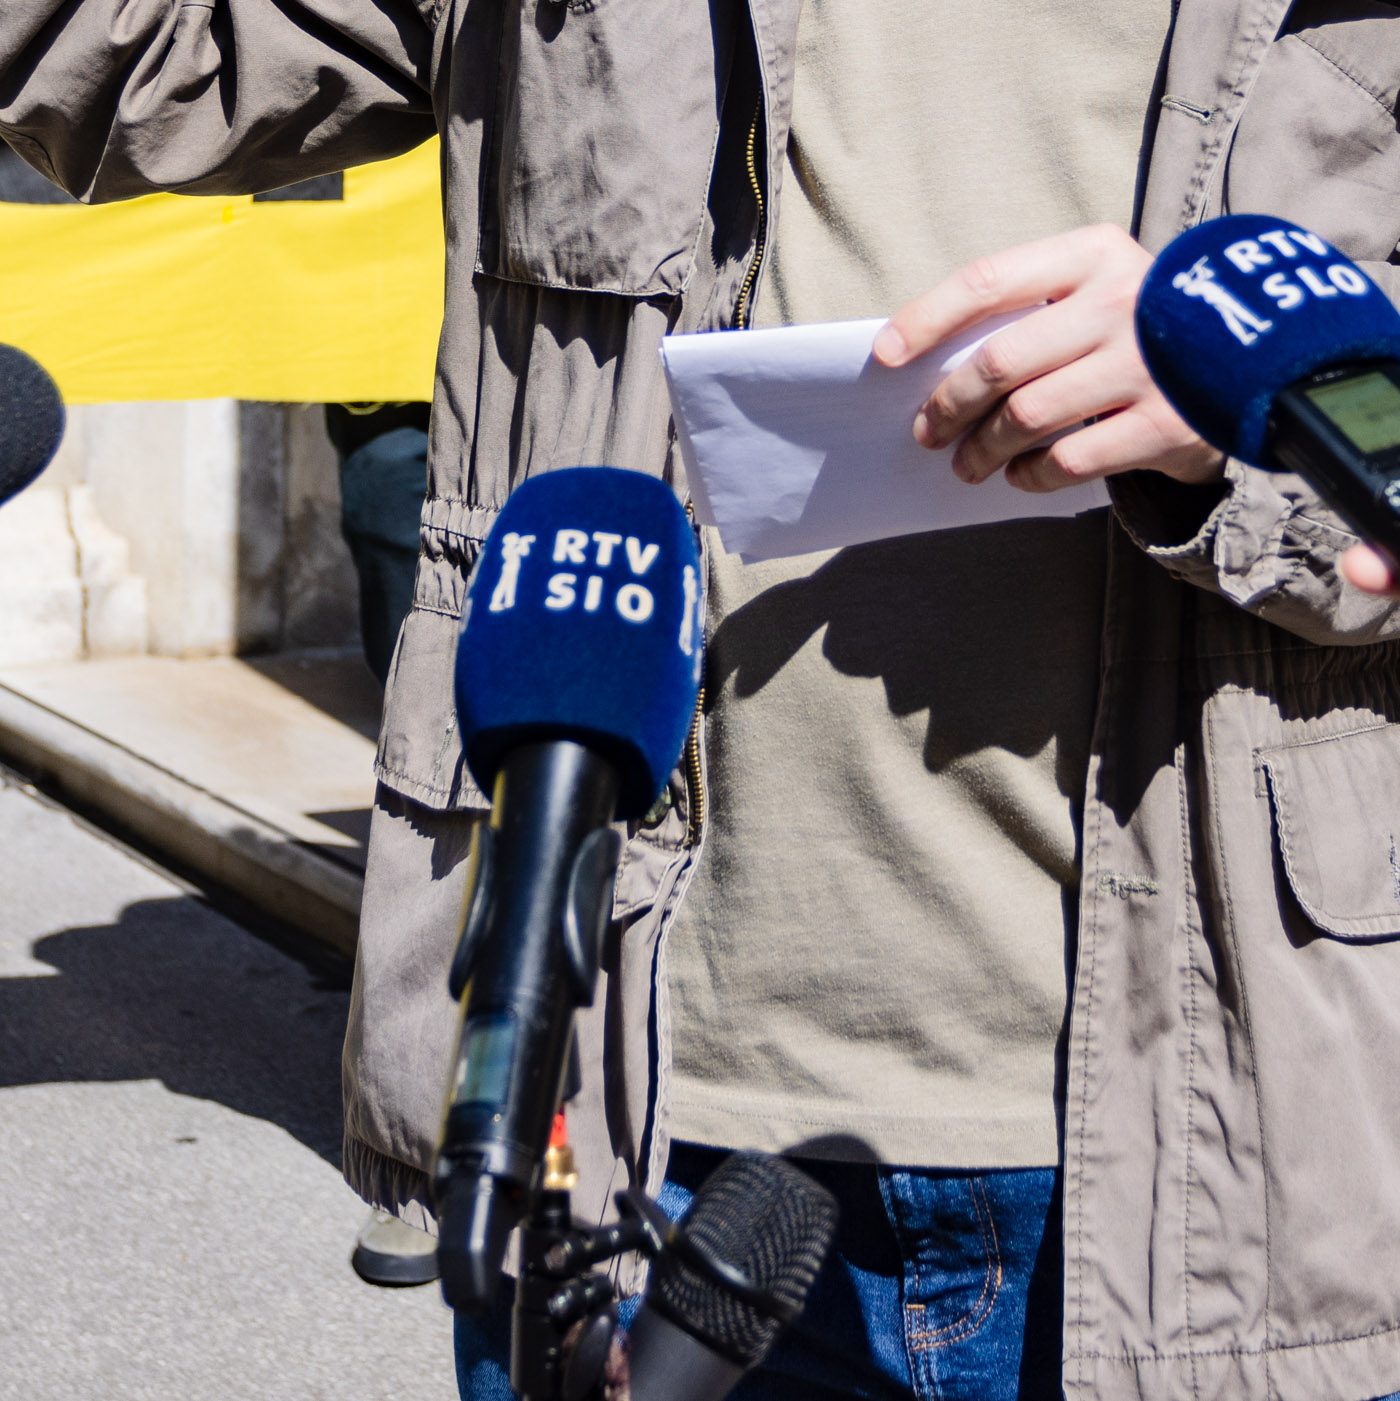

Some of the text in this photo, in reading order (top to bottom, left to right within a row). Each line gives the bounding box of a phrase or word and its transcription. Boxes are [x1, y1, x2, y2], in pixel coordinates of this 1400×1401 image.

[1222, 229, 1329, 274] RTV
[1261, 263, 1368, 311] SLO
[551, 528, 661, 575] RTV
